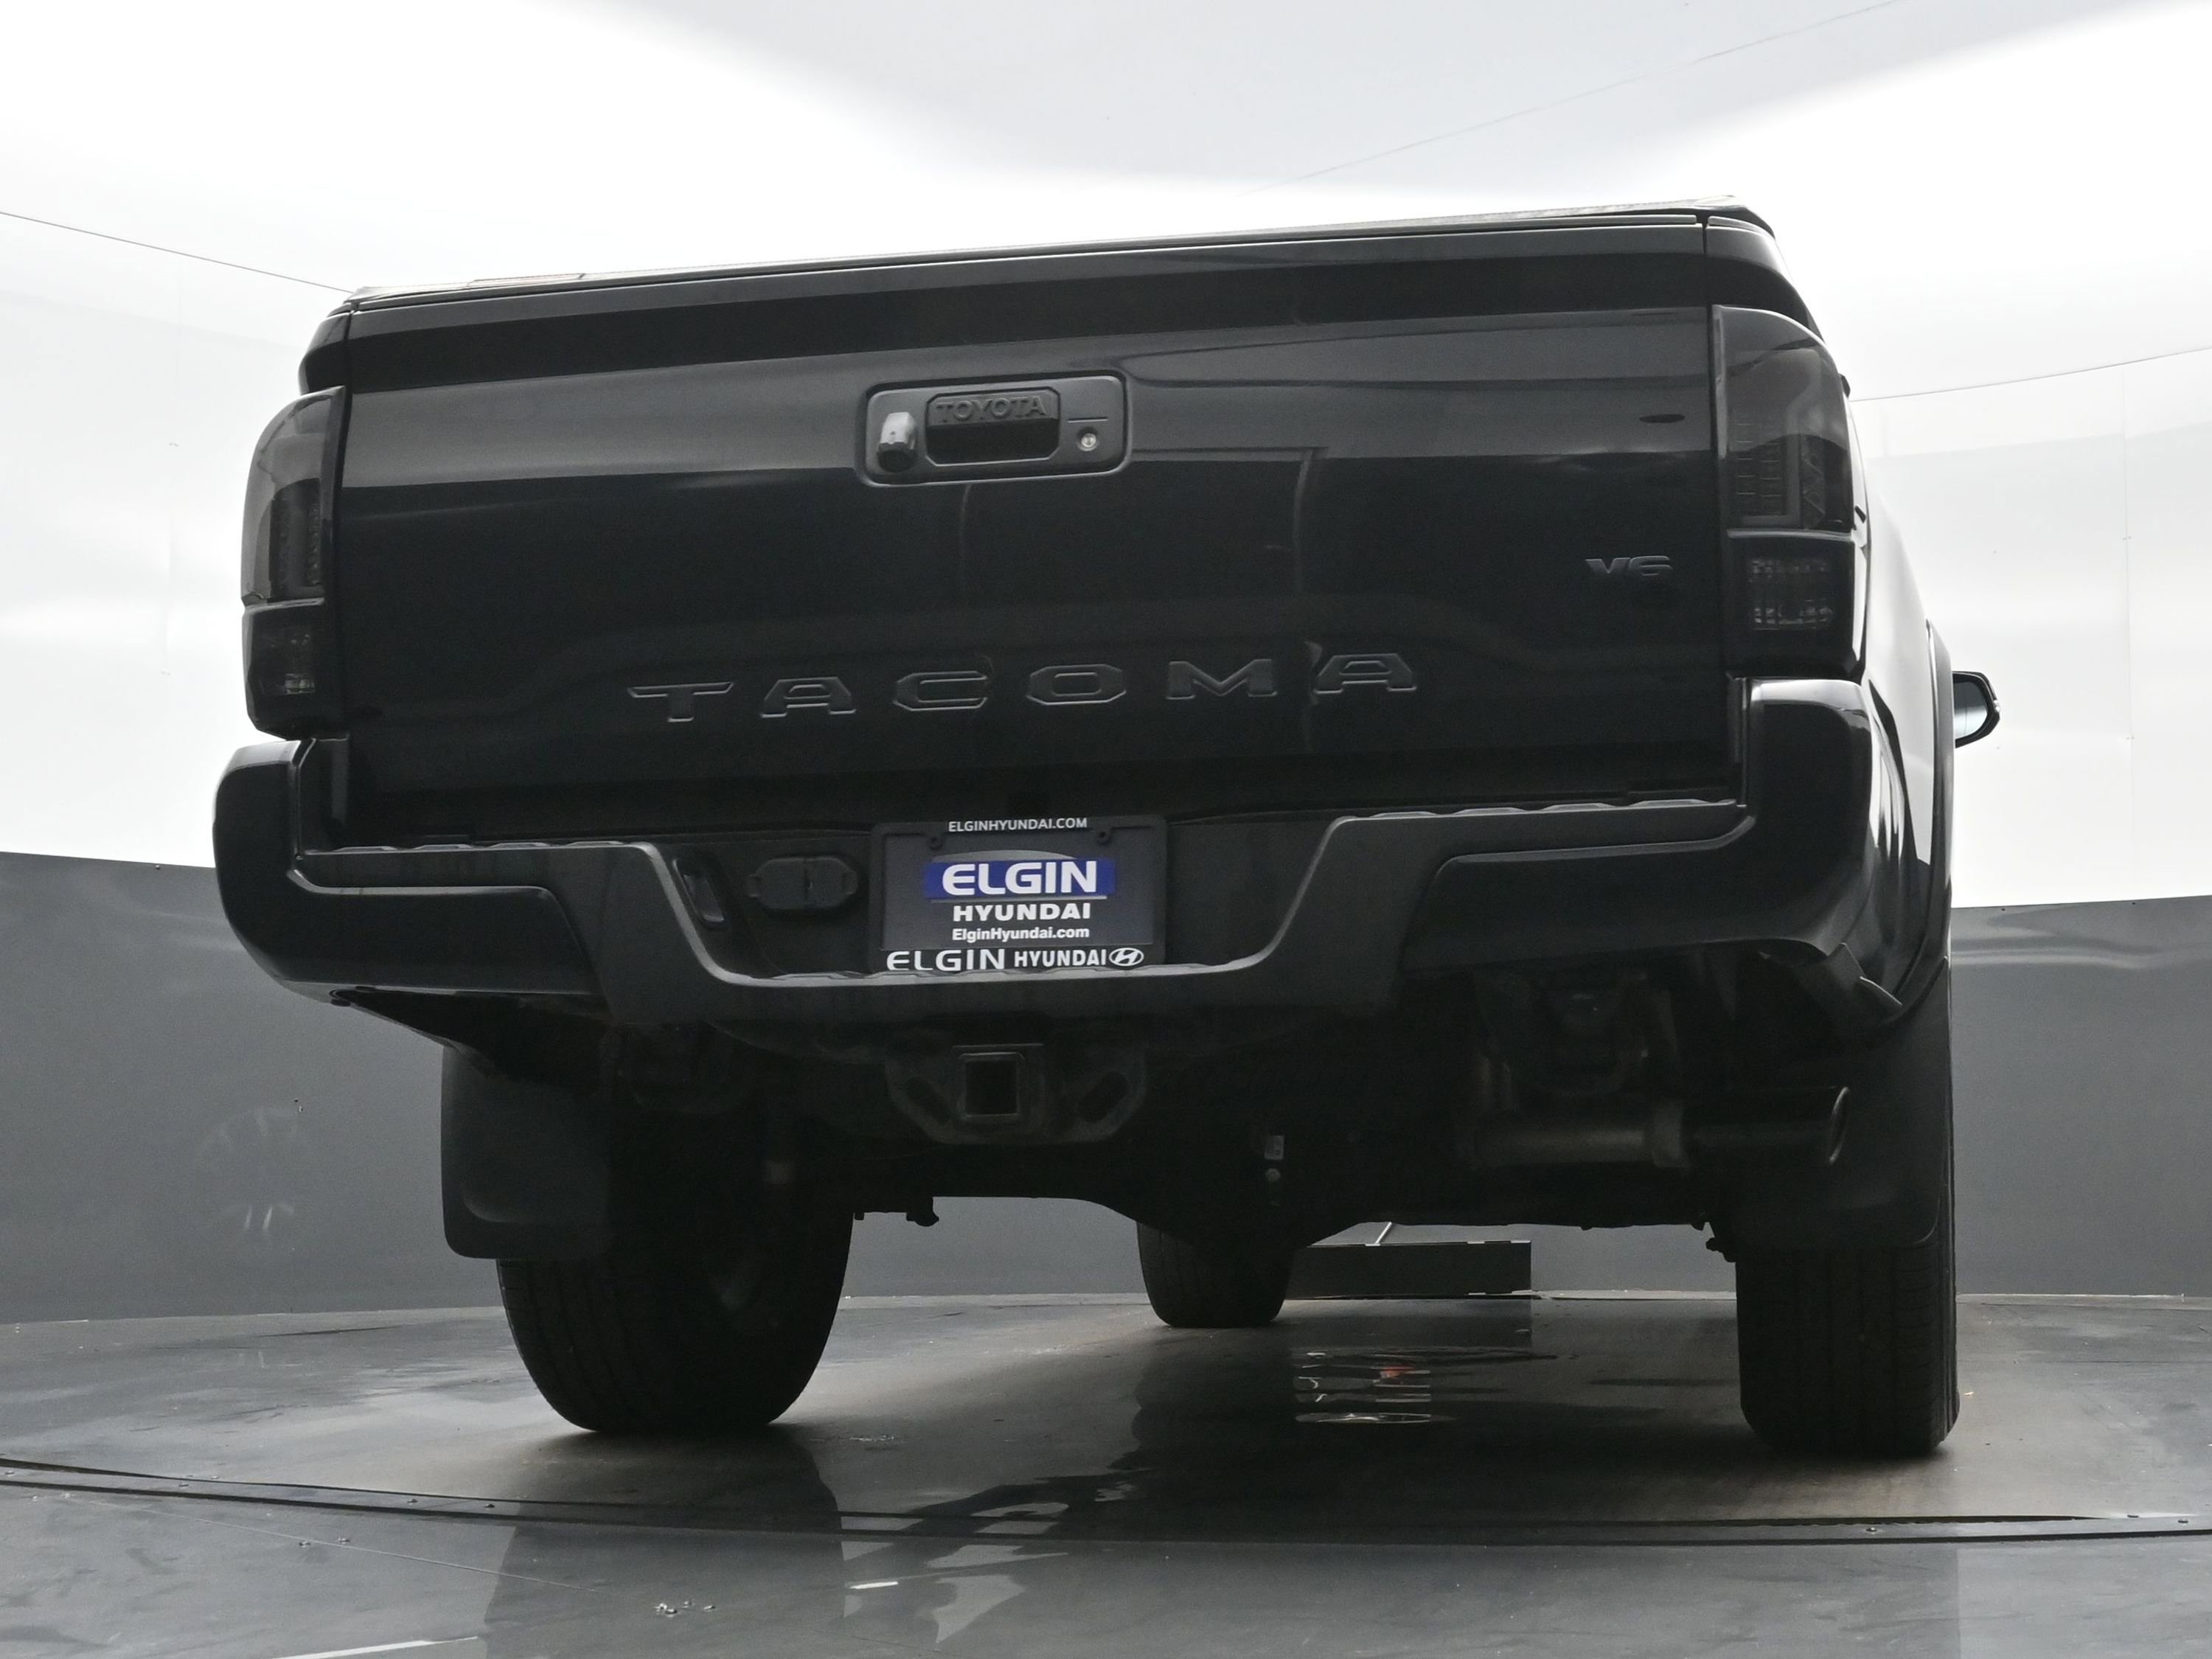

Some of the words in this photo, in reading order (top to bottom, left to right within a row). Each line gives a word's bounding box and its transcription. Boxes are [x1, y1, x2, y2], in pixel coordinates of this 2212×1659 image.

[936, 395, 1047, 423] TOYOTA
[1585, 554, 1674, 580] V6
[627, 653, 1417, 723] TACOMA
[948, 817, 1088, 832] ELGINHYUNDAI.COM
[942, 860, 1097, 896] ELGIN
[953, 902, 1091, 922] HYUNDAI
[952, 926, 1090, 943] ElginHyundai.com
[886, 948, 1006, 972] ELGIN
[1014, 949, 1106, 968] HYUNDAI
